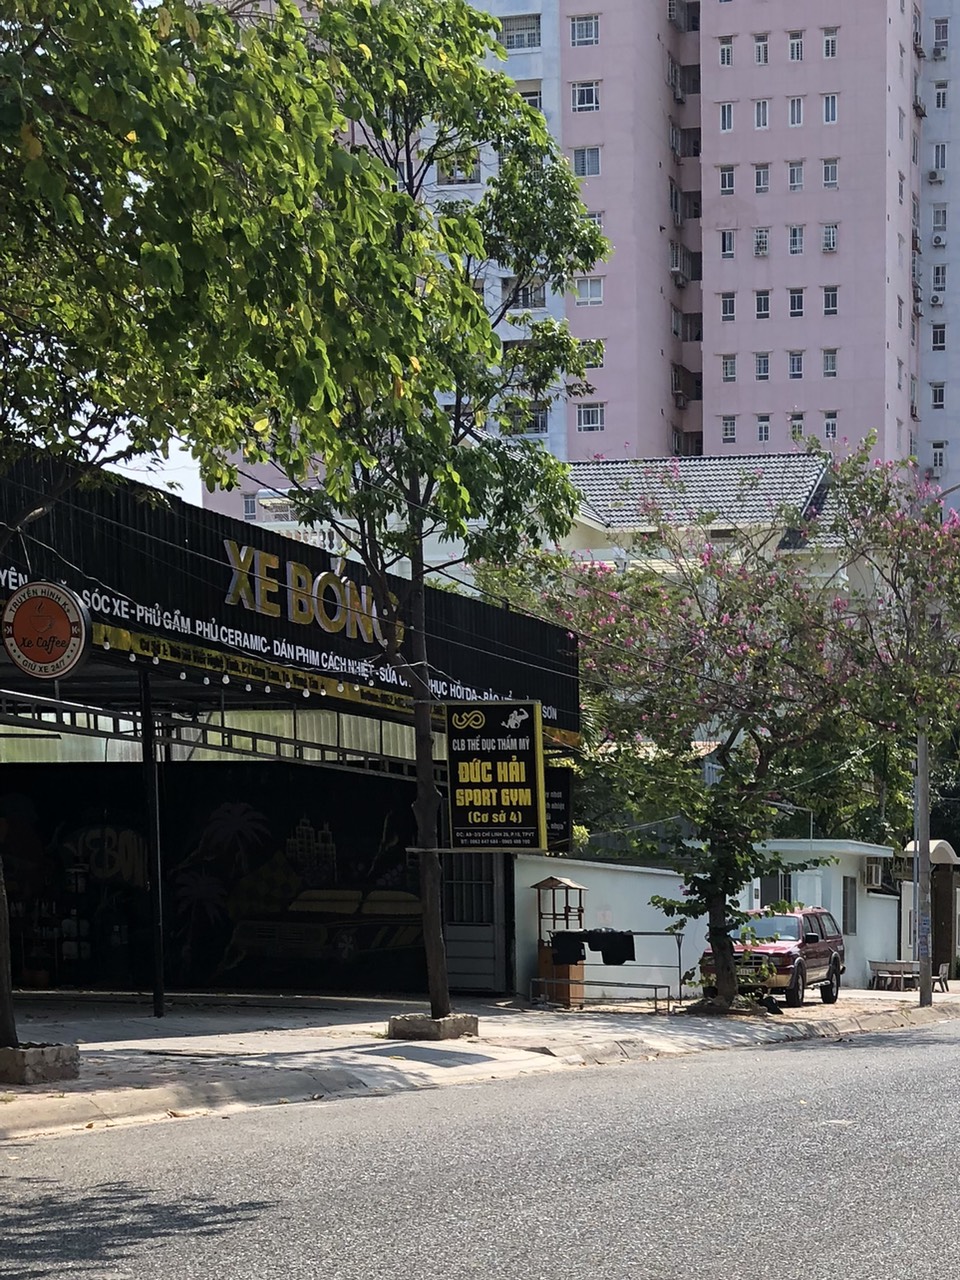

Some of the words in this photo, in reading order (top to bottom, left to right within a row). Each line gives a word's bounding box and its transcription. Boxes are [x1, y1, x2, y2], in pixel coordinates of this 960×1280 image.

[223, 539, 281, 617] XE
[41, 588, 61, 604] HÌNH
[36, 636, 67, 654] Coffee
[82, 588, 111, 614] SÓC
[195, 617, 219, 642] PHỦ
[274, 639, 294, 661] DÁN
[295, 649, 320, 667] PHIM
[321, 651, 347, 672] CÁCH
[542, 705, 558, 720] SƠN
[39, 665, 49, 673] XE
[452, 739, 466, 751] CLB
[481, 738, 496, 753] DỤC
[458, 758, 493, 783] ĐỨC
[497, 755, 526, 783] HẢI
[456, 789, 498, 806] SPORT
[501, 788, 532, 806] GYM
[468, 811, 489, 824] (Cơ
[492, 810, 508, 823] sở
[510, 811, 522, 824] 4)
